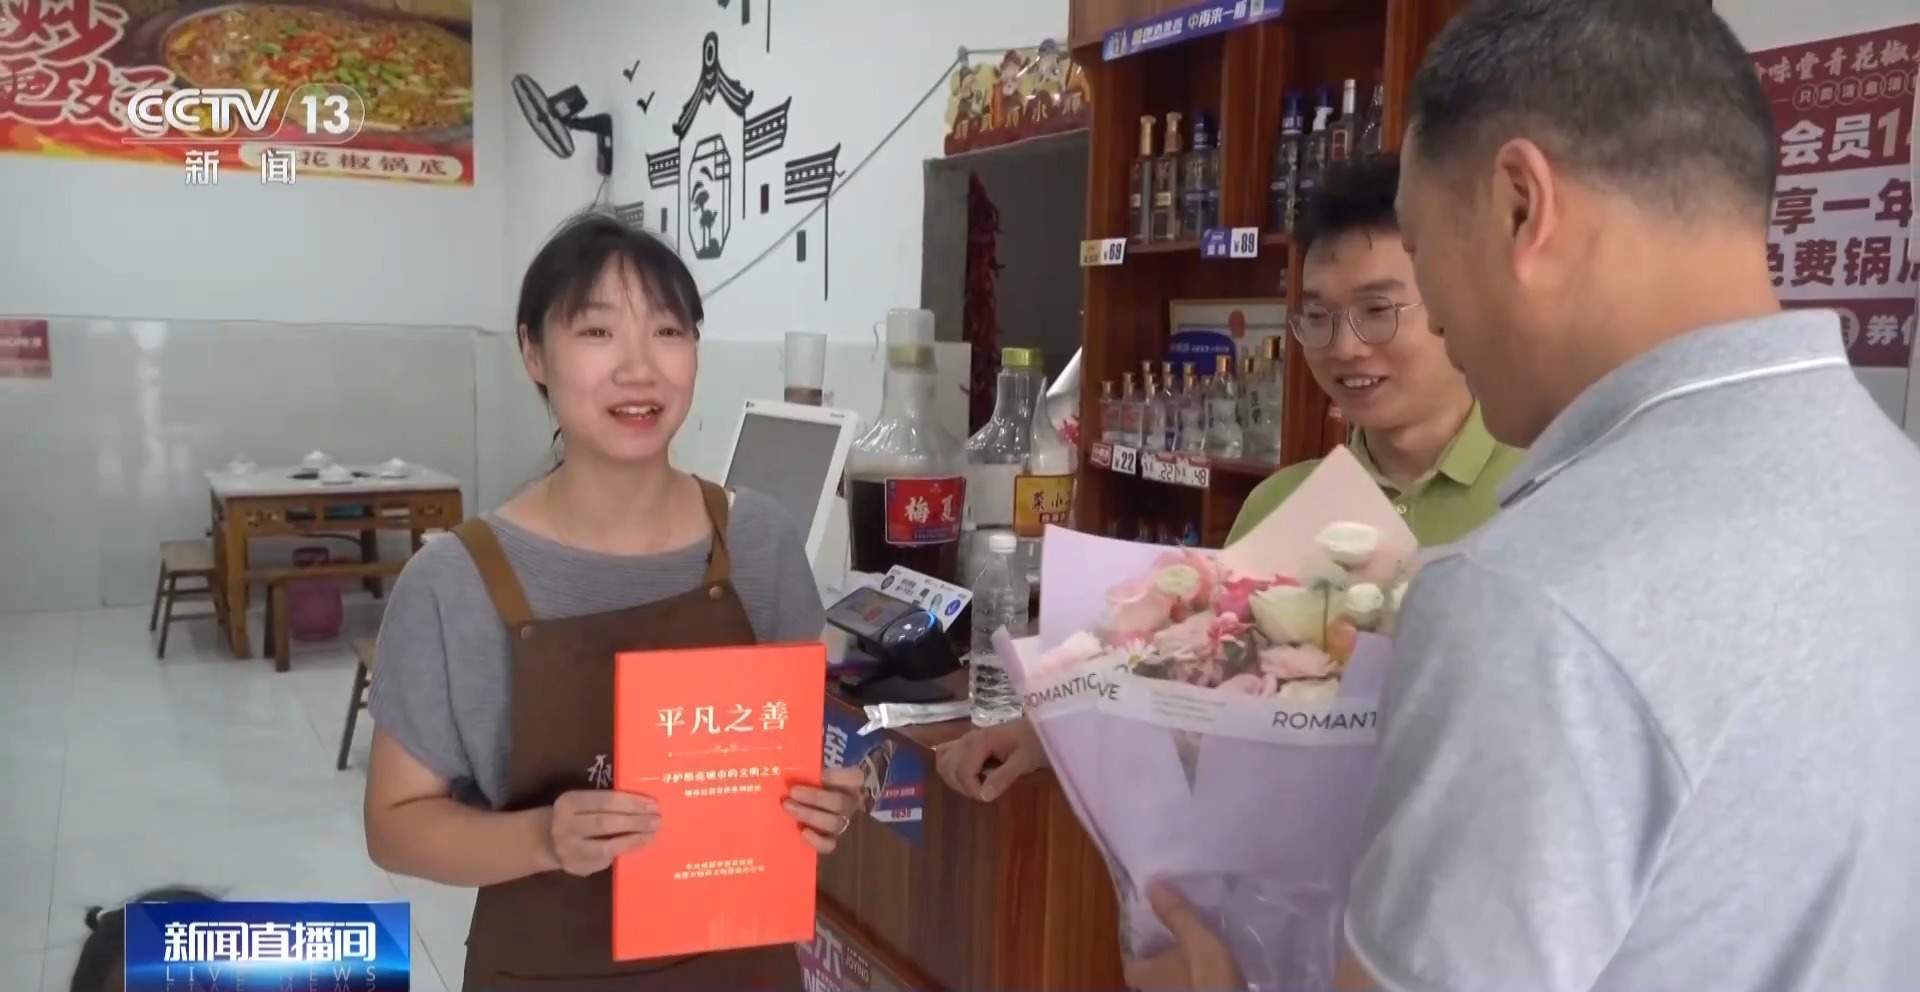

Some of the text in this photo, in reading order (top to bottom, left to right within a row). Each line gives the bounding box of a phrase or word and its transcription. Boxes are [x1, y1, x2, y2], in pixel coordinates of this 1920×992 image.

[1754, 39, 1920, 83] 味堂青花椒
[1780, 107, 1912, 167] 会员1
[262, 148, 447, 176] 花椒锅底
[656, 702, 788, 737] 平凡之善
